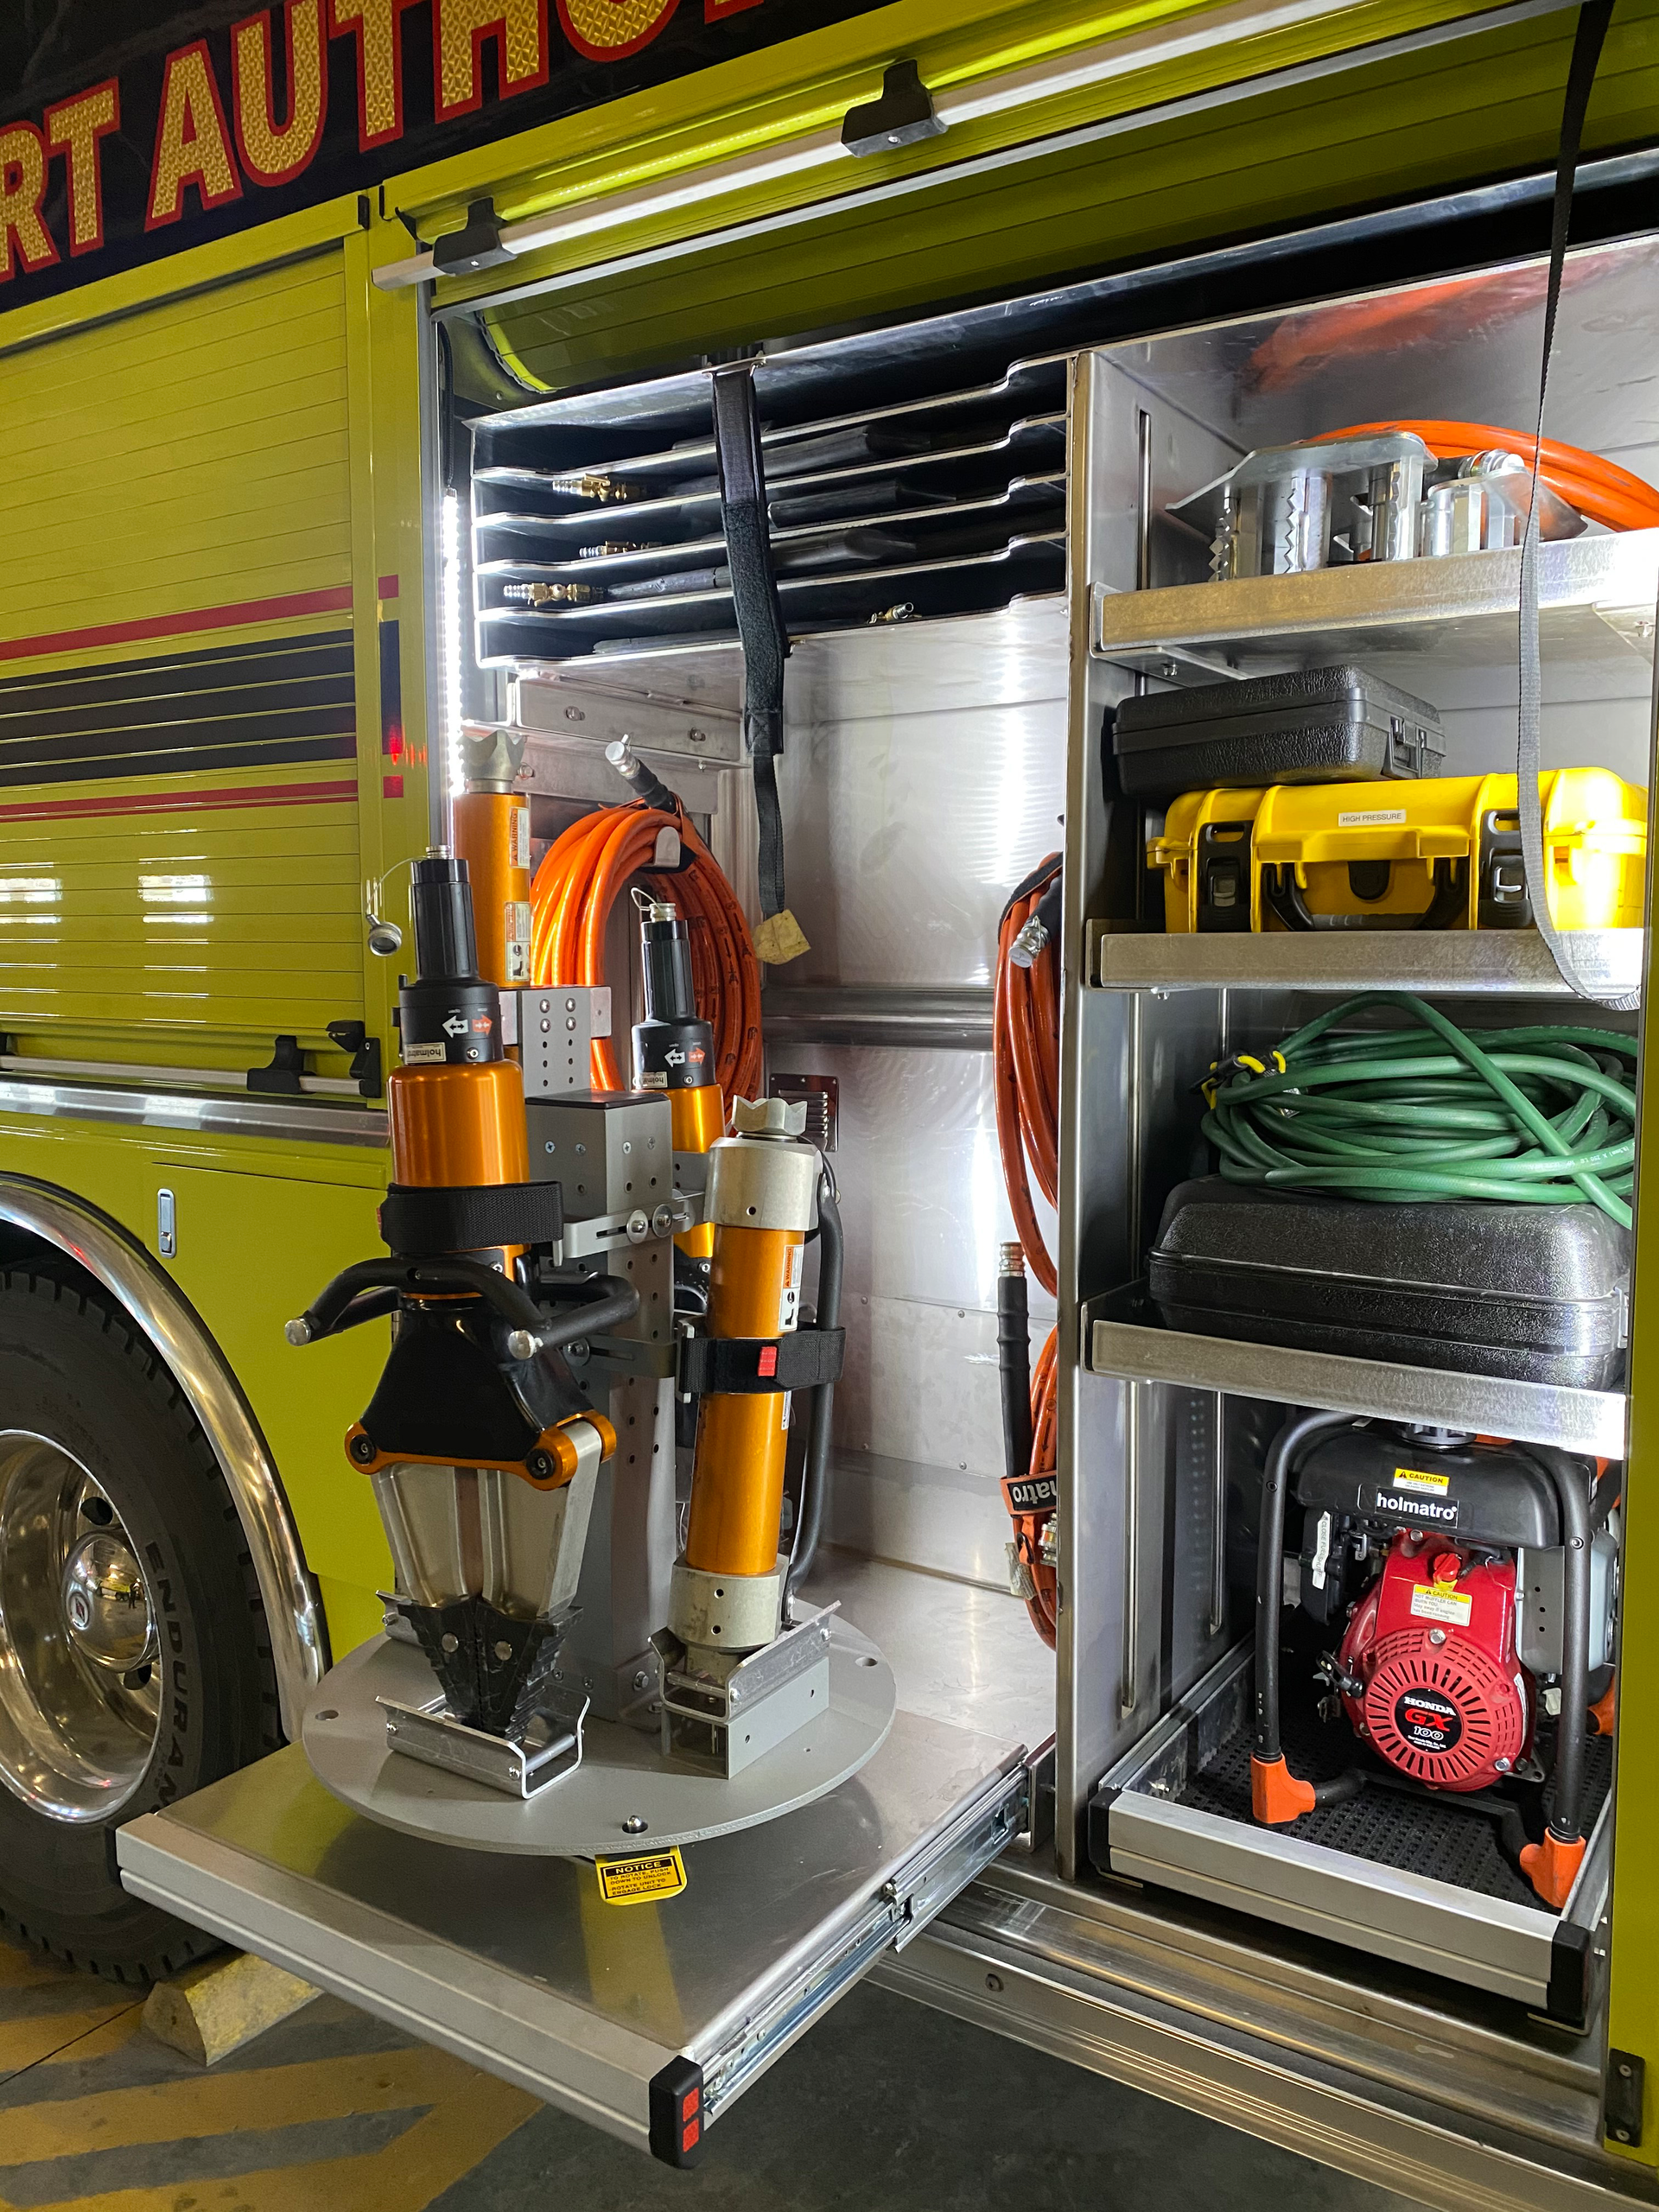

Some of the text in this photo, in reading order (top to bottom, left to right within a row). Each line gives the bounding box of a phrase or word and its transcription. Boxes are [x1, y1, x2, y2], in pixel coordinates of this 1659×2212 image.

[1362, 812, 1402, 822] PRESSURE
[1408, 1472, 1444, 1484] CAUTION
[1376, 1492, 1456, 1521] holmatro
[1432, 1589, 1459, 1600] CAUTION
[1404, 1696, 1457, 1716] HONDA
[1405, 1708, 1453, 1732] GX
[1414, 1726, 1444, 1740] 100
[615, 1861, 662, 1874] NOTICE
[643, 1871, 671, 1879] UNLOCK
[612, 1887, 641, 1896] ENGAGE
